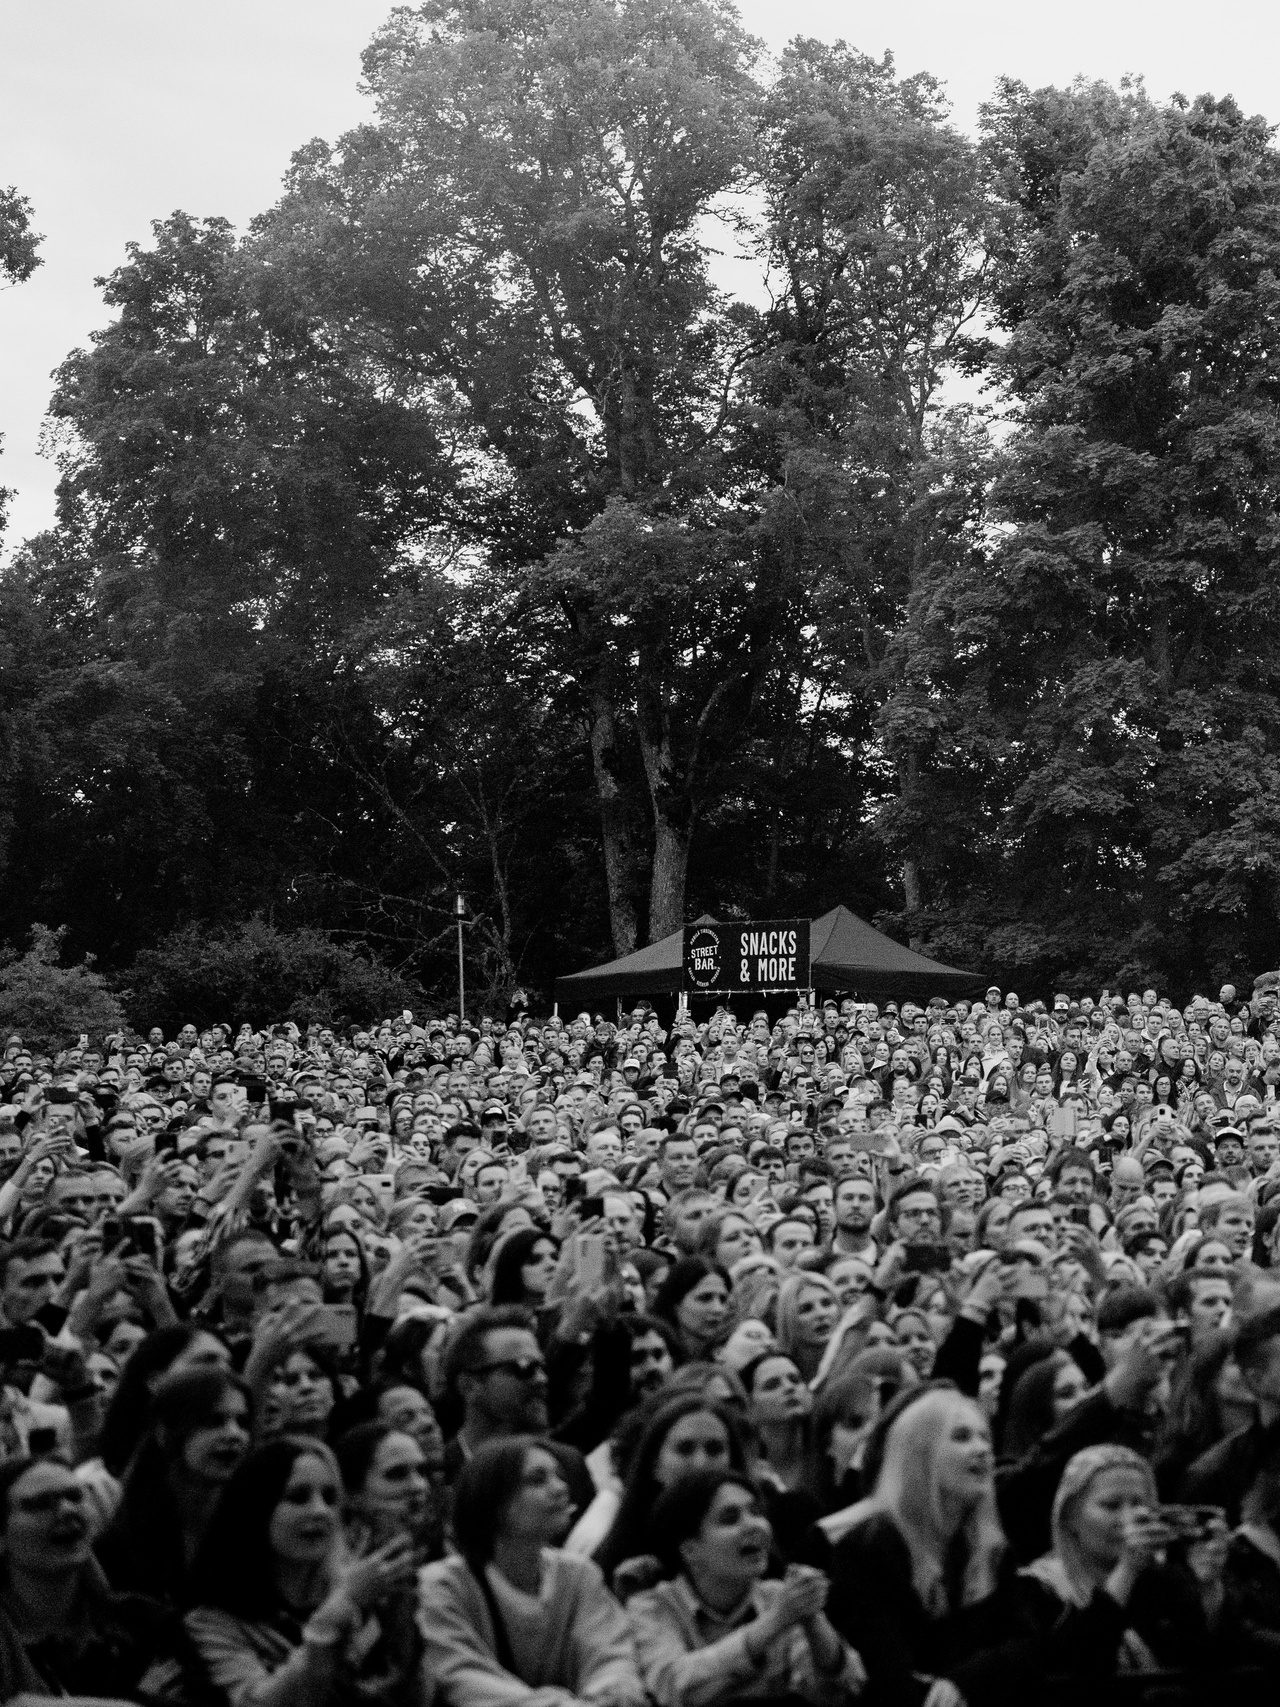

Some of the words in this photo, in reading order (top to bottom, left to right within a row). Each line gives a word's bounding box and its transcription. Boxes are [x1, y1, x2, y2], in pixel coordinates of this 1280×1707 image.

[691, 945, 718, 959] STREET
[740, 930, 797, 956] SNACKS
[694, 958, 714, 971] BAR
[740, 958, 750, 982] &
[758, 957, 796, 981] MORE
